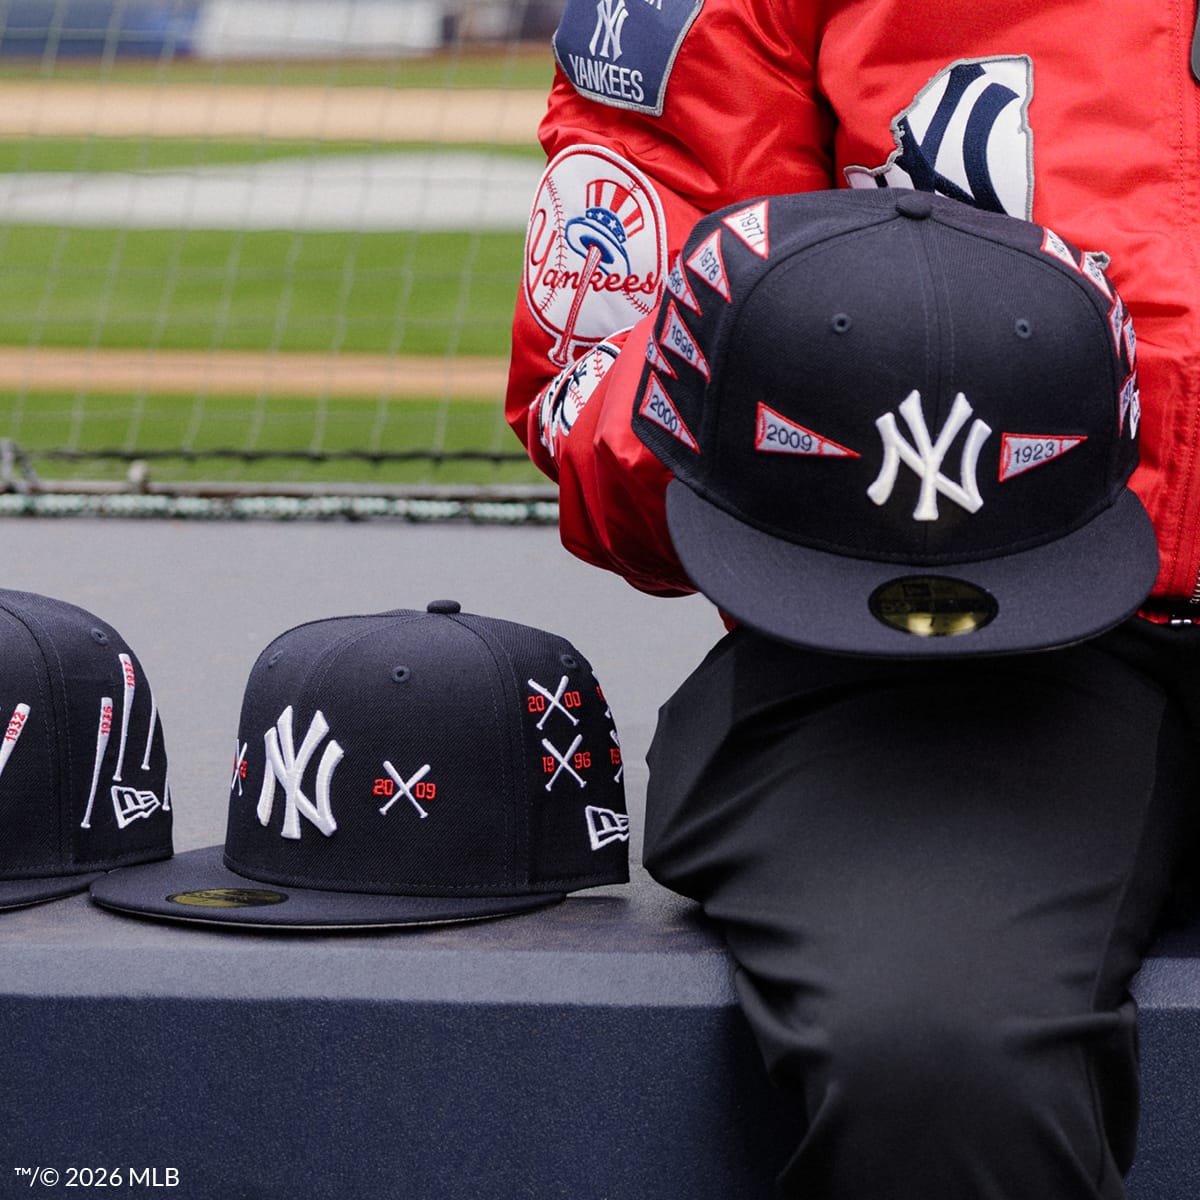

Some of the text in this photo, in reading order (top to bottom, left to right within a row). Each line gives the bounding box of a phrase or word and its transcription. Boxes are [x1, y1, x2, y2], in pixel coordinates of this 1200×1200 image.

[568, 53, 645, 103] YANKEES
[530, 208, 657, 298] Yankees
[670, 323, 694, 362] 1998
[649, 394, 678, 432] 2000
[765, 422, 814, 452] 2009
[867, 389, 992, 520] NY
[1013, 441, 1056, 465] 1923
[5, 711, 27, 742] 1932
[257, 705, 345, 839] NY
